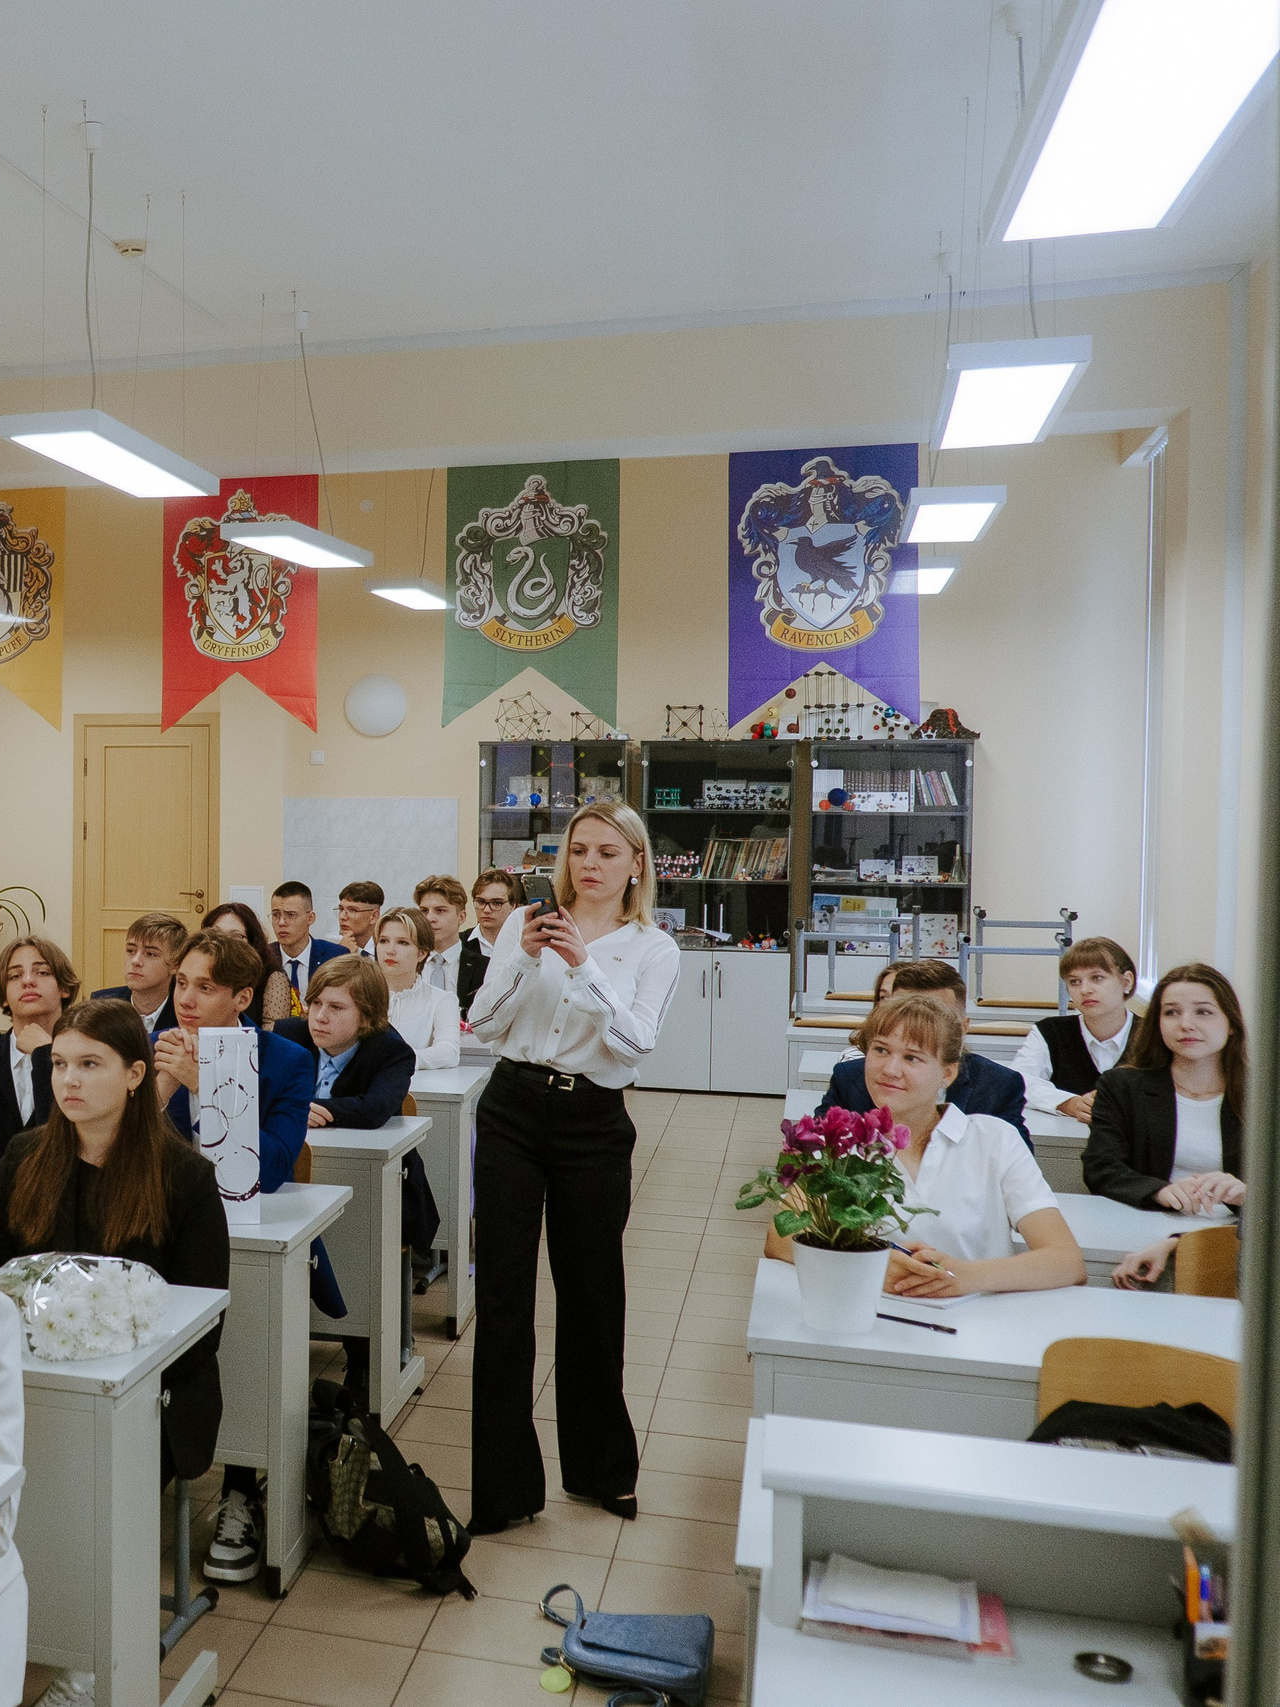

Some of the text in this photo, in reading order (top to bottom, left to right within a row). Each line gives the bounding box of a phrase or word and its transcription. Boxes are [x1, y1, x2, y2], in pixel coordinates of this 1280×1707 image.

[492, 625, 566, 647] SLYTHERIN
[780, 624, 860, 646] RAVENCLAW
[202, 638, 272, 657] GRYFFINDOR
